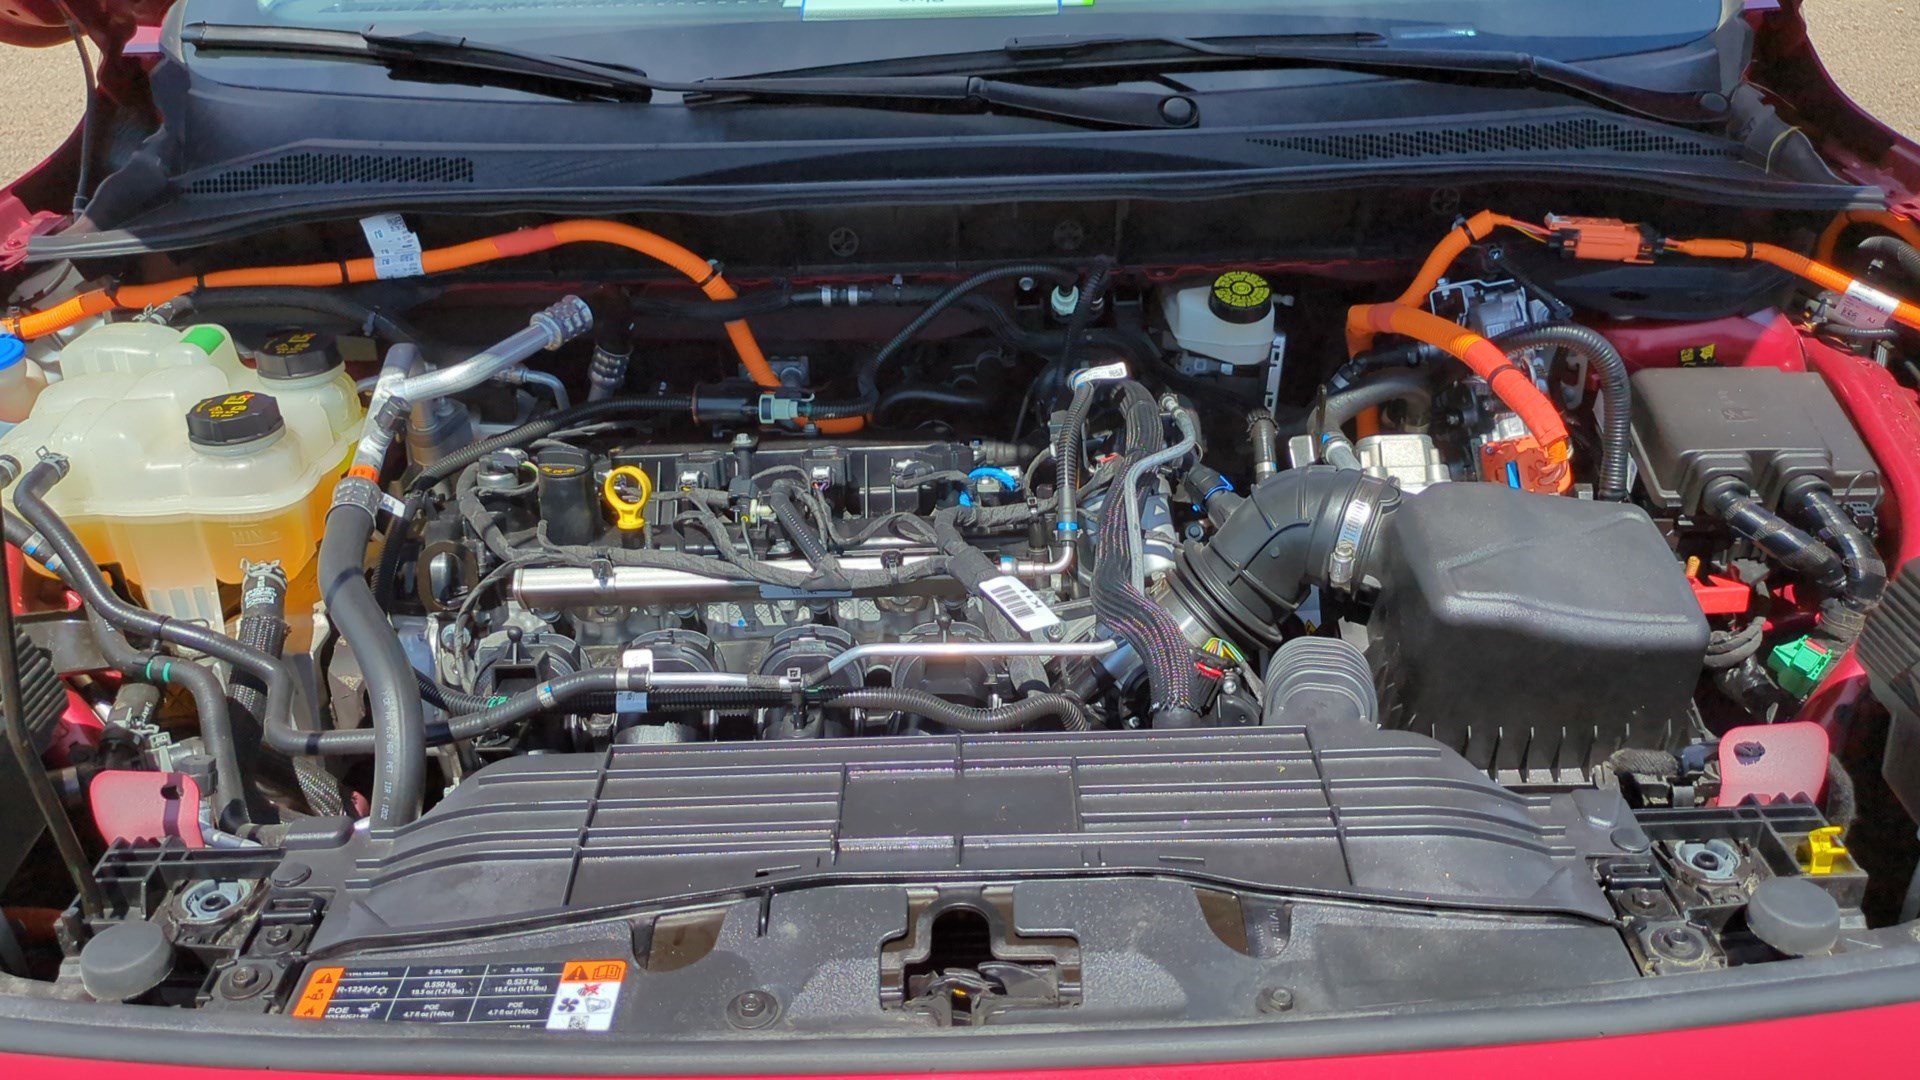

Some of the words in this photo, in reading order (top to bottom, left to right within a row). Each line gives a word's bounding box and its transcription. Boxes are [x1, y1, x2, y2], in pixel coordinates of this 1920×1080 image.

[446, 981, 457, 989] kg
[528, 978, 539, 986] kg
[336, 985, 377, 994] R-1234yf
